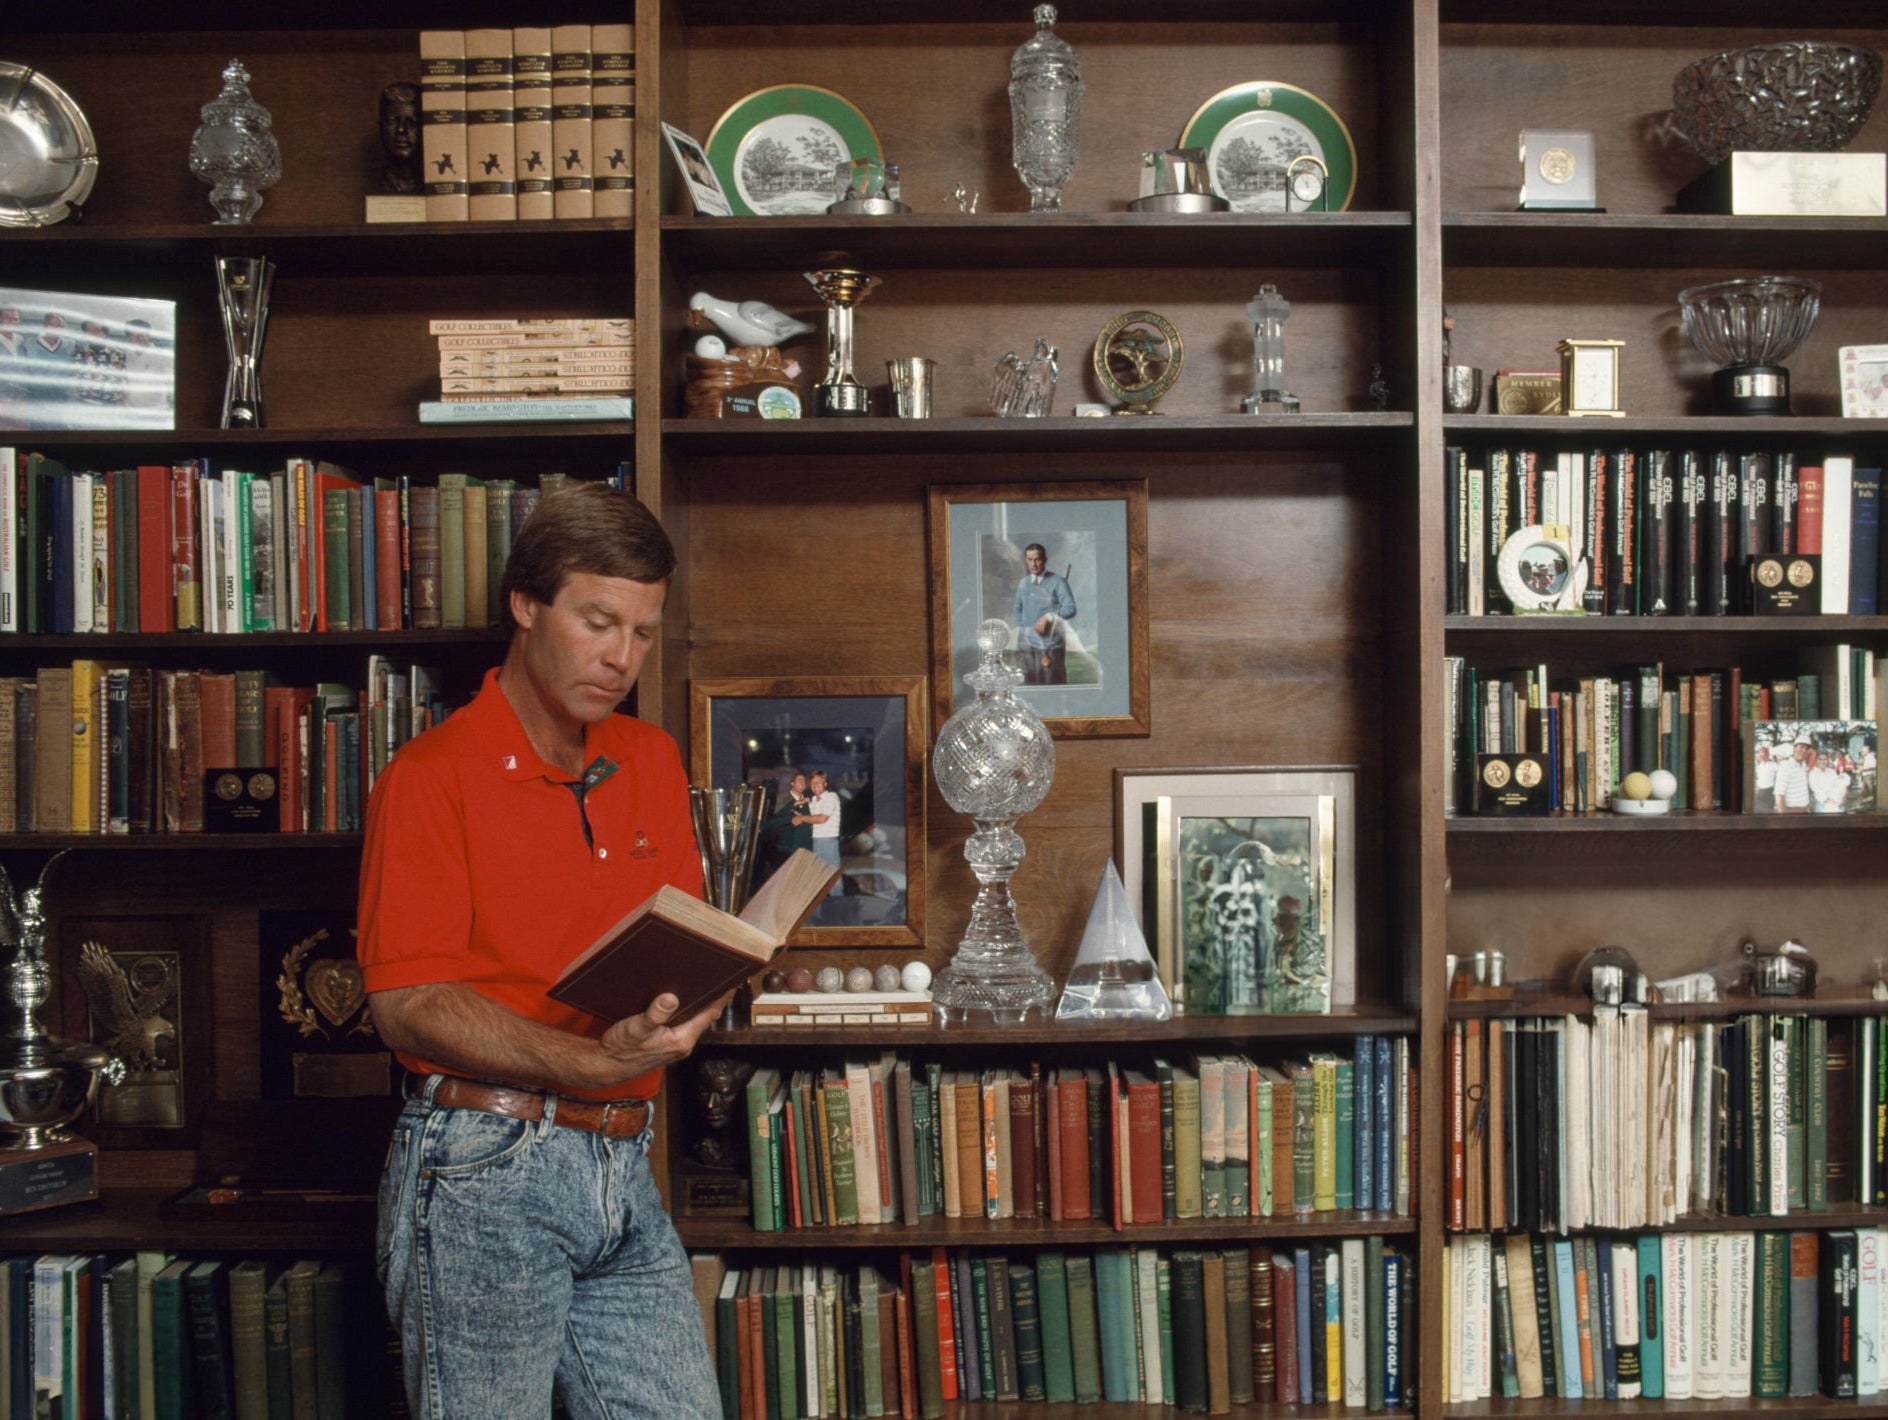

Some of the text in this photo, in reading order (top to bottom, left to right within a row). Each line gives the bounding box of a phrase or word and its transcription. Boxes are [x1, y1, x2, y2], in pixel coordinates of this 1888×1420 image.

[109, 690, 128, 701] OLF
[1773, 1049, 1785, 1090] GOLF
[1773, 1092, 1785, 1136] STORY
[1773, 1184, 1782, 1210] Price
[1678, 1239, 1686, 1254] The
[1711, 1238, 1719, 1253] The
[1740, 1238, 1748, 1253] The
[1678, 1256, 1686, 1280] World
[1711, 1256, 1719, 1279] World
[1740, 1256, 1748, 1279] World
[1862, 1235, 1877, 1285] GOLF
[1678, 1281, 1686, 1290] of
[1711, 1280, 1719, 1289] of
[1740, 1280, 1748, 1289] of
[1352, 1304, 1359, 1314] OF
[1388, 1263, 1397, 1376] THE WORLD OF GOLF
[1679, 1344, 1687, 1362] Golf
